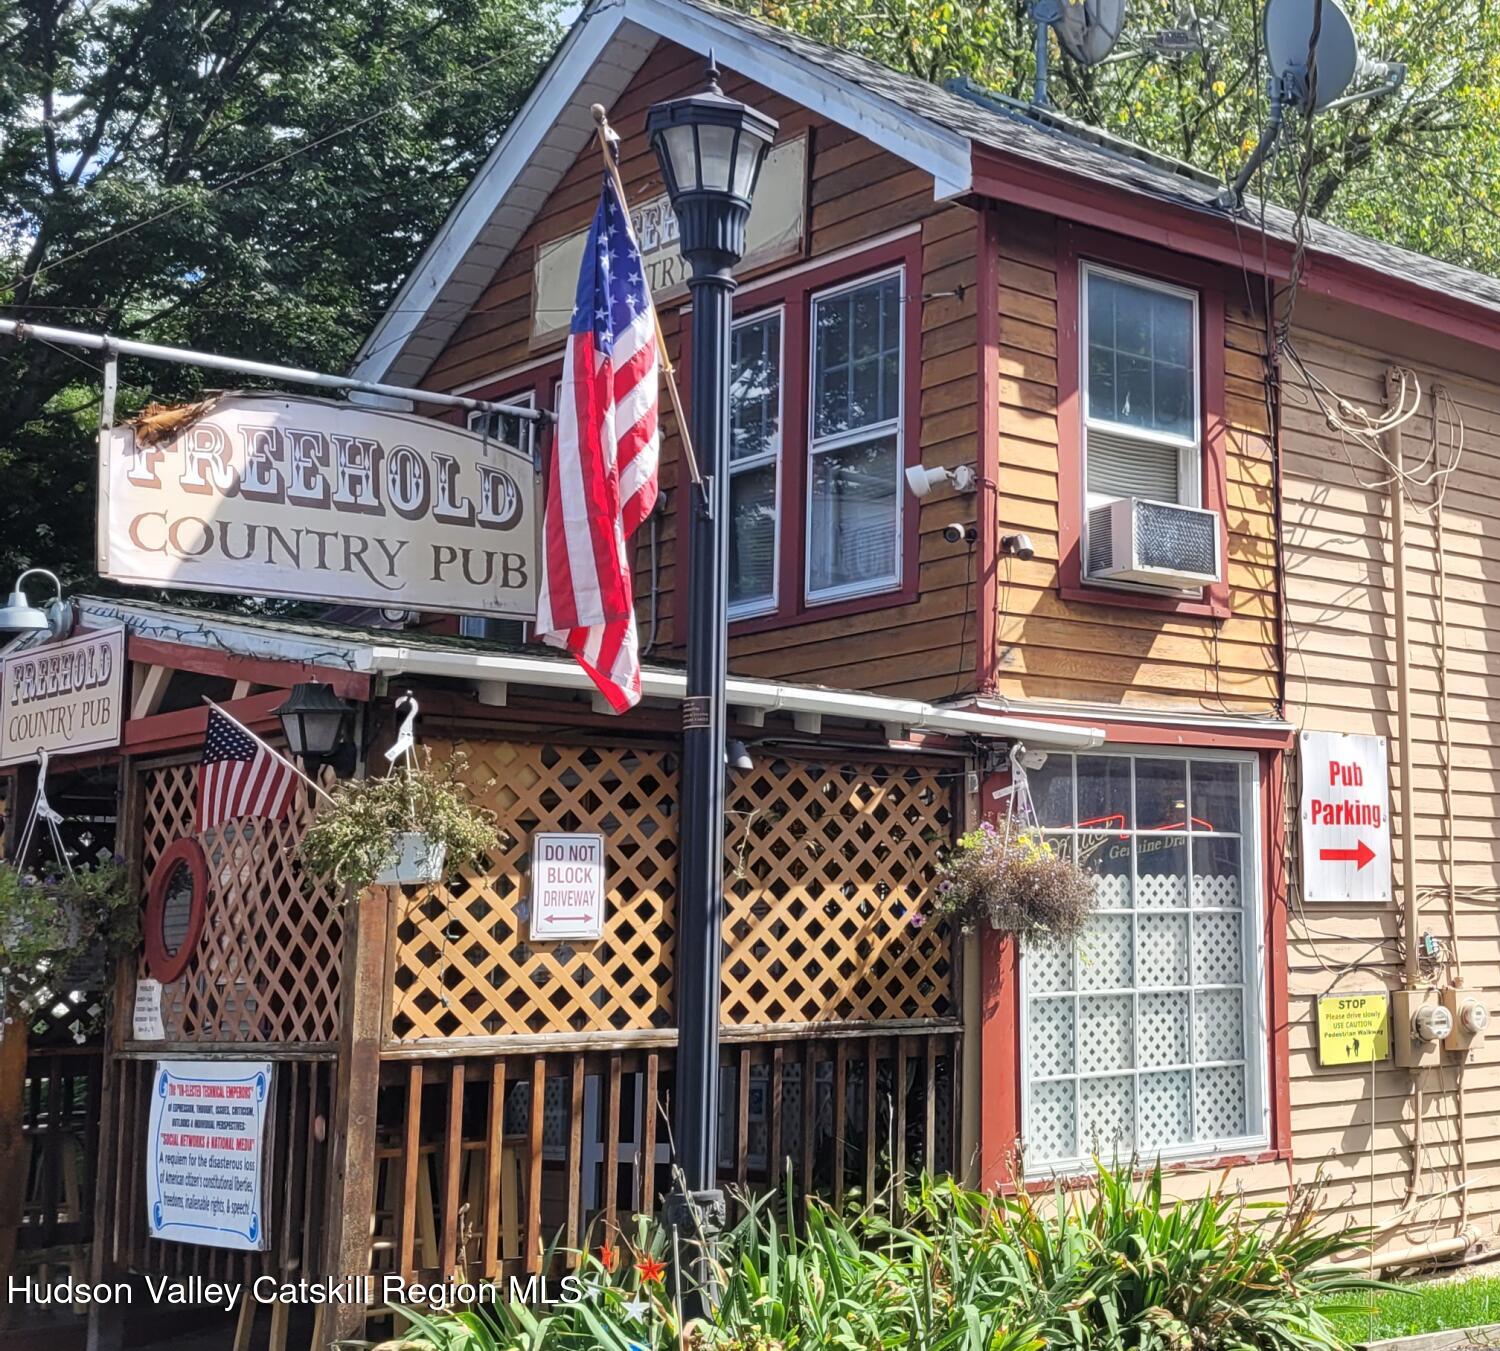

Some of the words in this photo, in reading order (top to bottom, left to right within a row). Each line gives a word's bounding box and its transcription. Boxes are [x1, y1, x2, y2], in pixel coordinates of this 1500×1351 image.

[127, 422, 524, 531] FREEHOLD
[128, 509, 410, 591] COUNTRY
[429, 544, 528, 589] PUB
[11, 642, 112, 706] FREEHOLD
[9, 703, 76, 742] COUNTRY
[81, 697, 110, 728] PUB
[1329, 761, 1363, 787] Pub
[1311, 799, 1381, 828] Parking
[545, 845, 564, 861] DO
[569, 845, 596, 862] NOT
[547, 867, 593, 884] BLOCK
[543, 890, 595, 907] DRIVEWAY
[1339, 999, 1366, 1010] STOP
[1346, 1011, 1361, 1019] drive
[1363, 1010, 1380, 1019] slowly
[1346, 1020, 1372, 1028] CAUTION
[159, 1151, 164, 1163] A
[165, 1152, 187, 1167] requiem
[188, 1152, 197, 1166] for
[198, 1153, 207, 1167] the
[244, 1156, 255, 1171] loss
[159, 1169, 165, 1184] of
[166, 1170, 184, 1186] American
